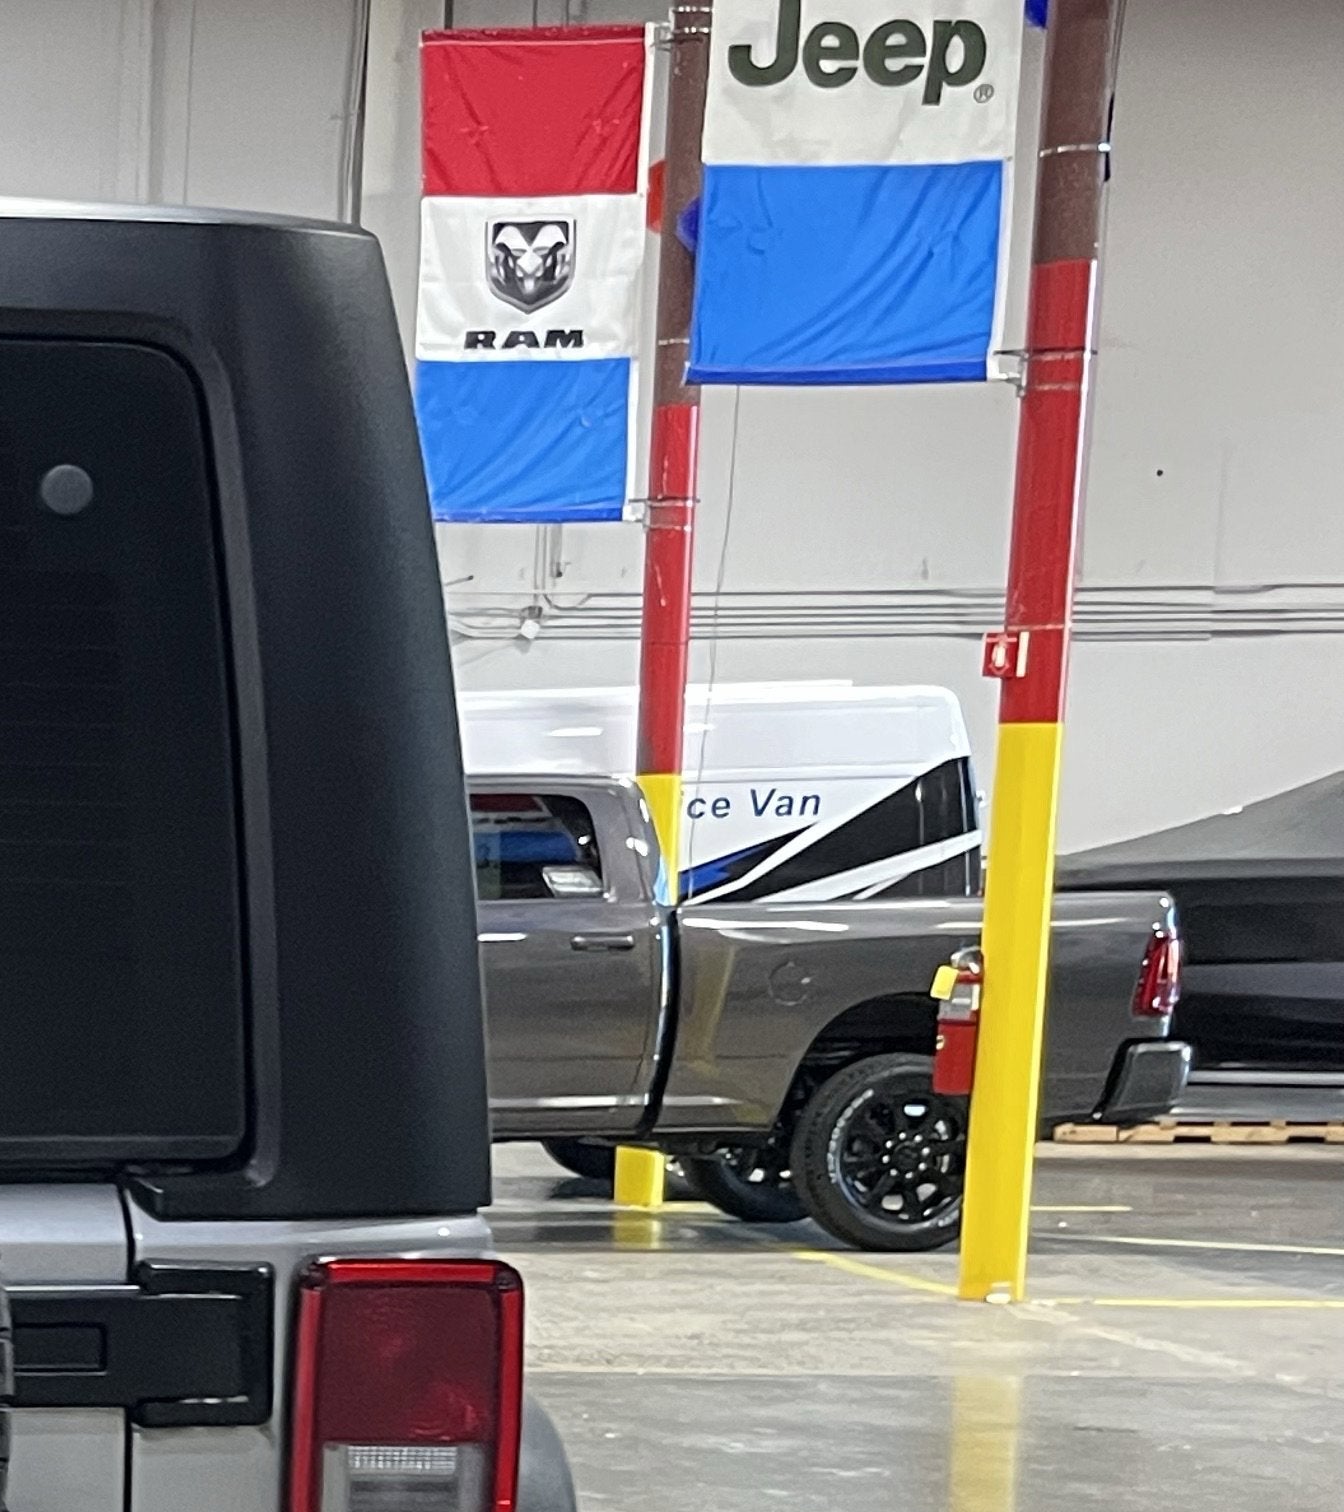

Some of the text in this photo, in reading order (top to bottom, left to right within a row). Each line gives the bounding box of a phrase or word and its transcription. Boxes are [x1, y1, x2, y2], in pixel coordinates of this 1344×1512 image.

[728, 0, 987, 105] Jeep
[464, 330, 584, 350] RAM
[684, 788, 821, 820] ce Van
